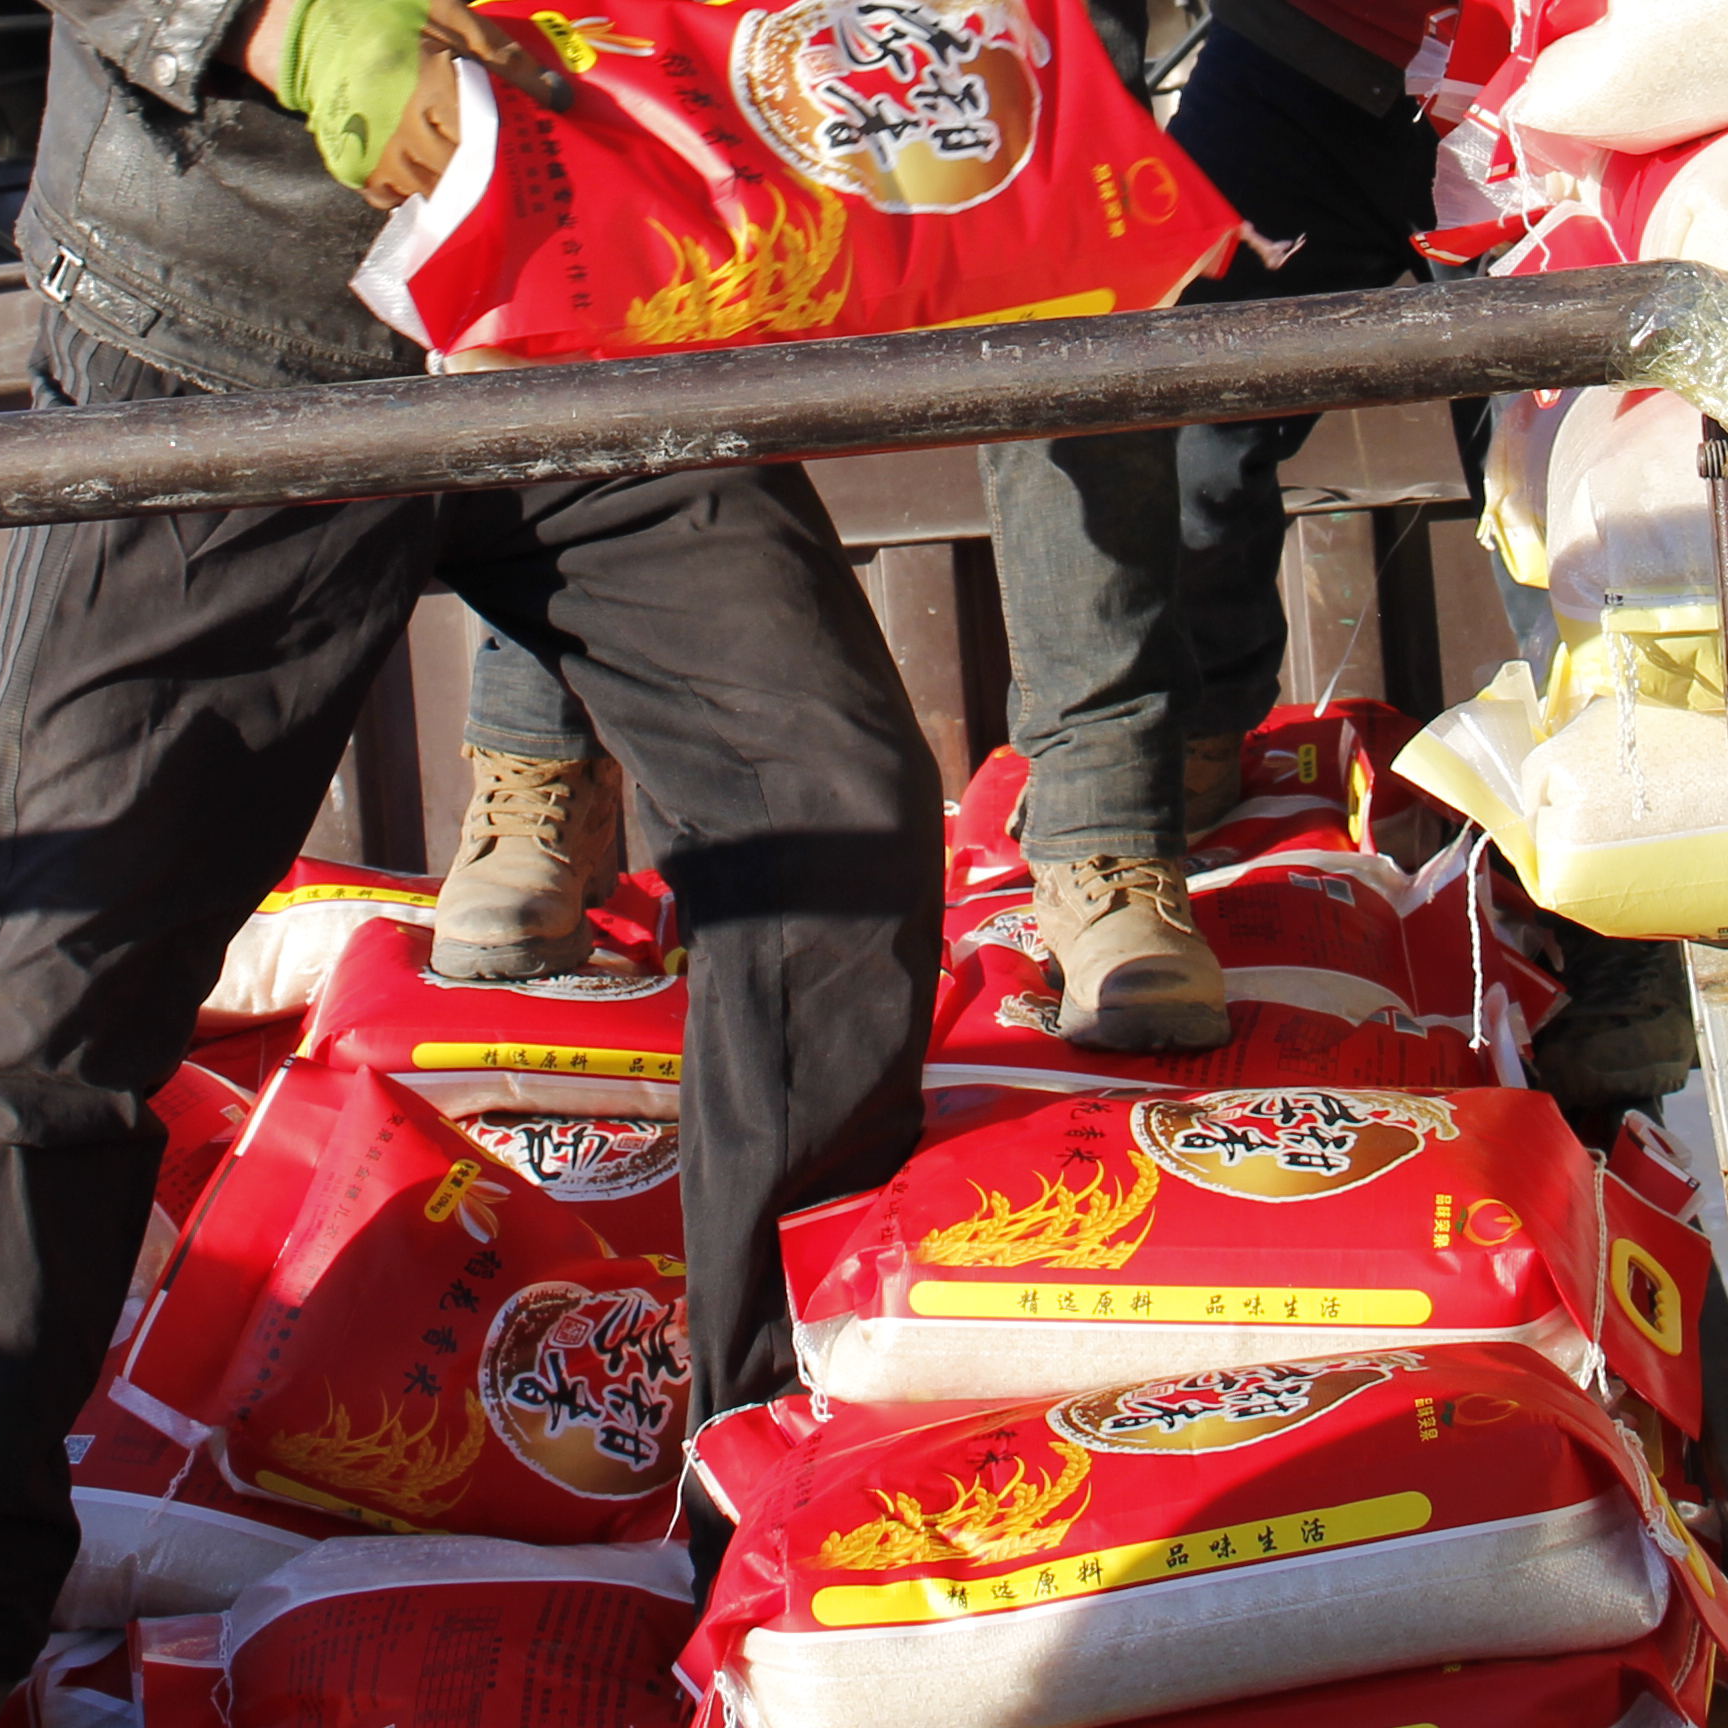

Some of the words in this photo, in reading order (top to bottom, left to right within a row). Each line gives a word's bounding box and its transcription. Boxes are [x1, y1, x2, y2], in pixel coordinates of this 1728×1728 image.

[482, 1043, 589, 1070] 精选原料
[1433, 1193, 1453, 1249] 品味突泉
[1016, 1289, 1153, 1316] 精选原料
[1205, 1293, 1342, 1320] 品味生活
[1414, 1398, 1439, 1442] 品味突泉
[945, 1558, 1103, 1610] 精选原料
[1166, 1517, 1327, 1568] 品味生活
